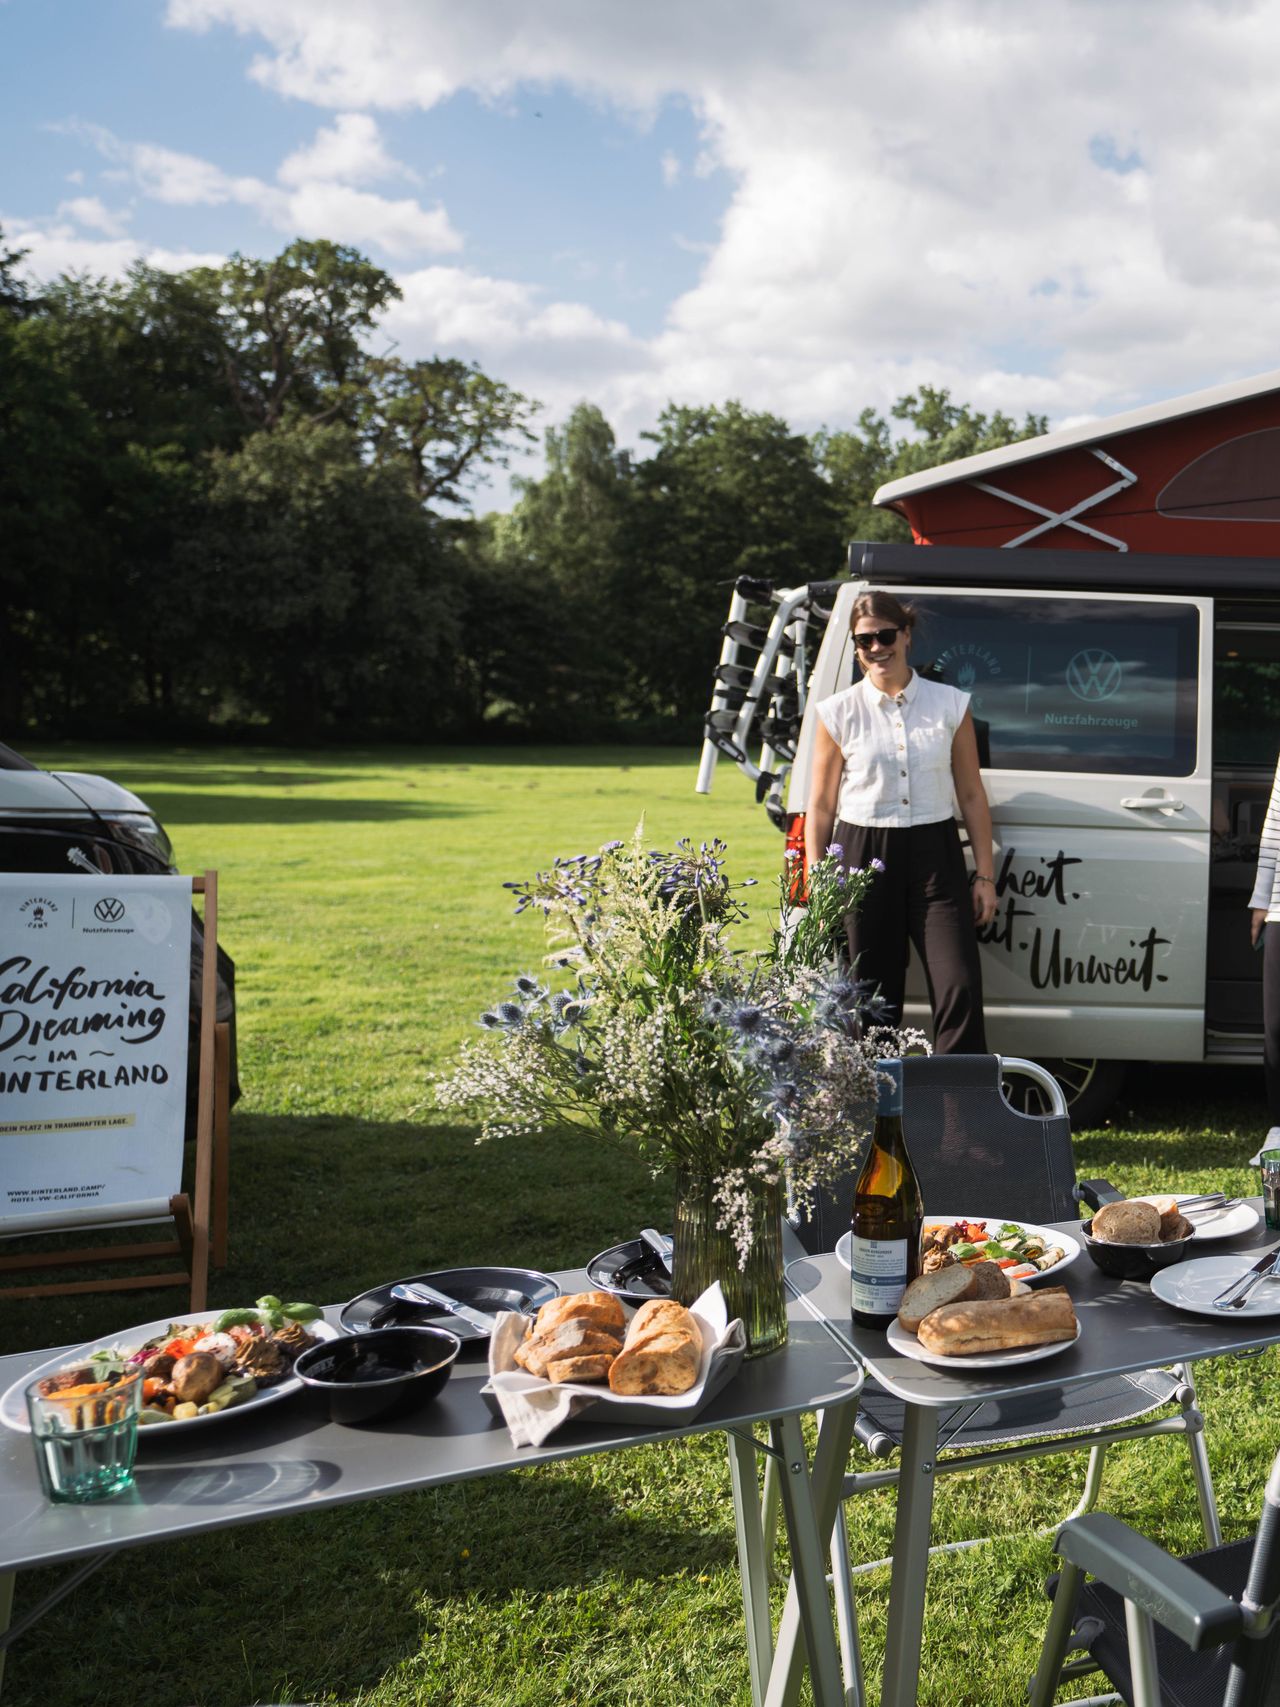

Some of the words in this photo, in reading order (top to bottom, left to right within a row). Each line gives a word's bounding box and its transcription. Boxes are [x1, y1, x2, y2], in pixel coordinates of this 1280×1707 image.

[933, 644, 1001, 675] HINTERLAND
[1045, 713, 1138, 730] Nutzfahrzeuge
[996, 847, 1083, 905] heit.
[82, 927, 135, 935] Nutzfahrzeuge
[1030, 927, 1173, 992] Unweit.
[0, 1002, 166, 1049] Dreaming
[48, 1050, 77, 1063] IM
[0, 1064, 168, 1094] INTERLAND
[19, 1123, 42, 1132] PLATZ
[54, 1119, 106, 1129] TRAUMHAFTER
[109, 1117, 128, 1126] LAGE.
[7, 1184, 106, 1197] WWW.HINTERLAND.CAMP/
[10, 1191, 100, 1203] HOTEL-VW-CALIFORNIA
